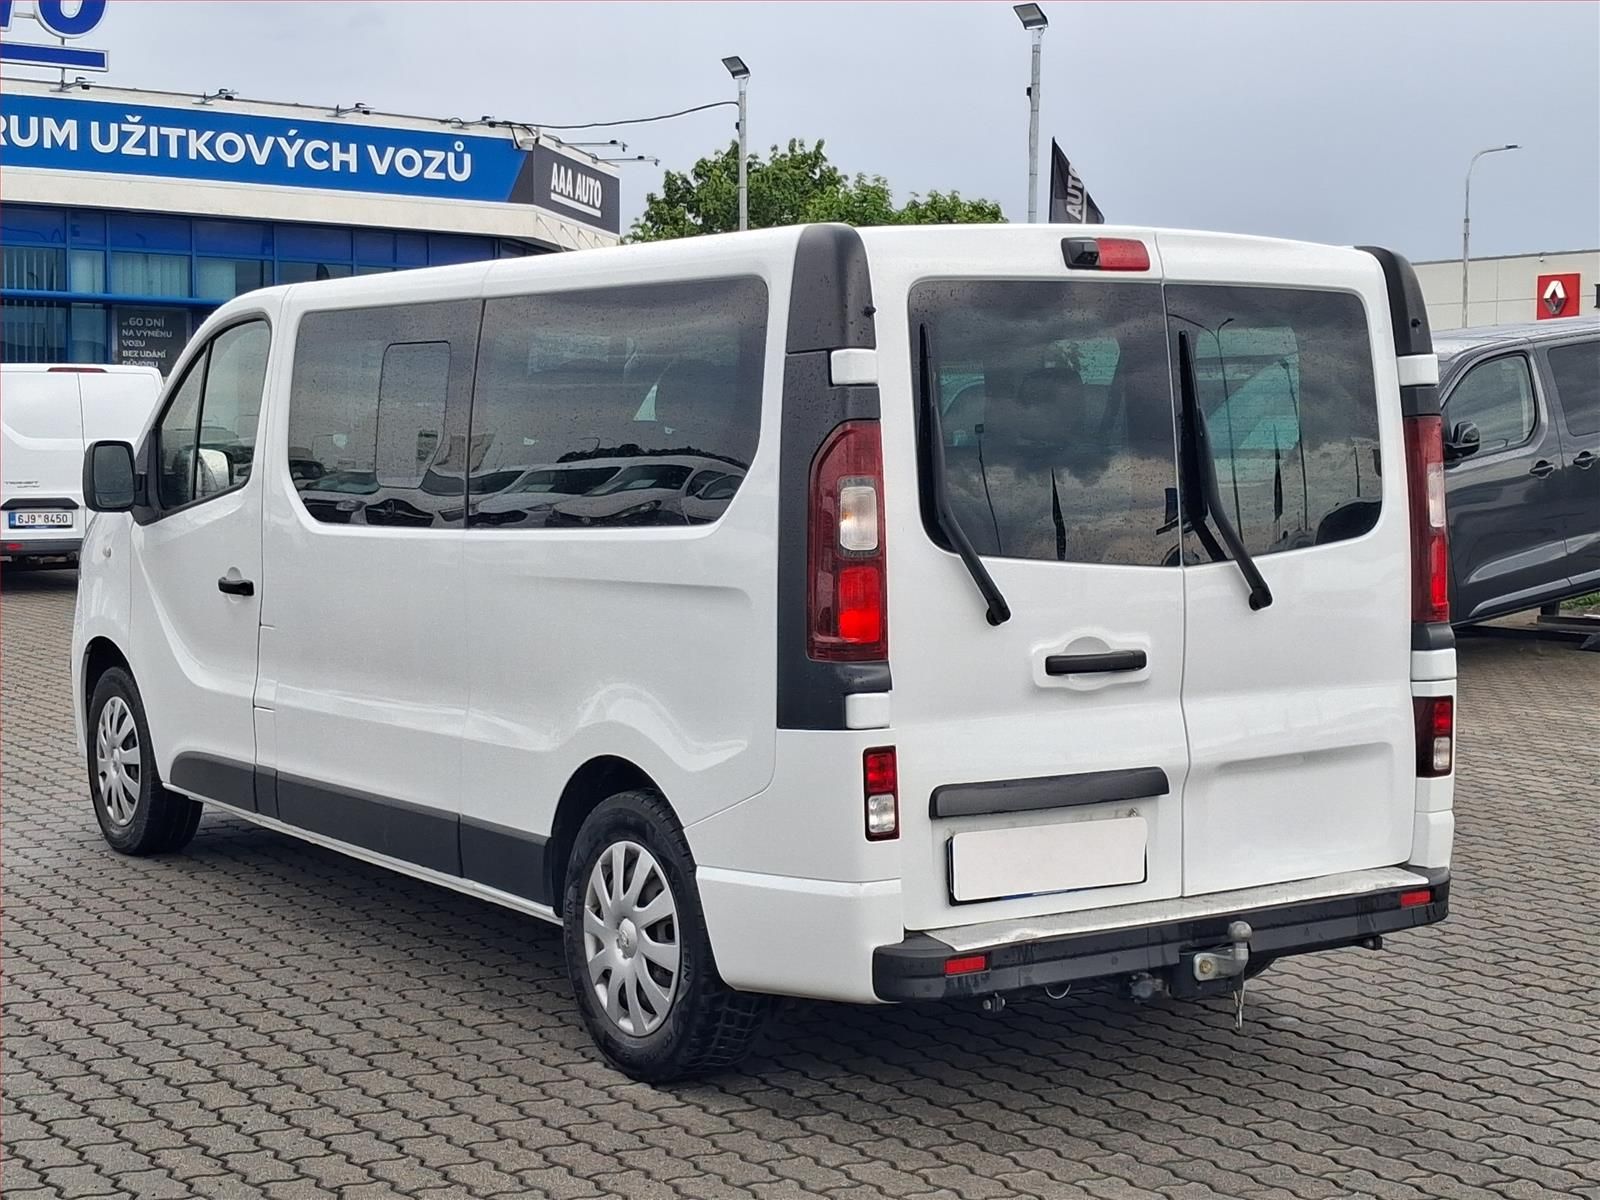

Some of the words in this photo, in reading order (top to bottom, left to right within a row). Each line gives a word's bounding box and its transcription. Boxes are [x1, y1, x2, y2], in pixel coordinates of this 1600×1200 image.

[90, 114, 357, 173] UŽITKOVÝCH
[367, 141, 472, 182] VOZŮ
[551, 162, 573, 198] AAA
[575, 172, 602, 209] AUTO
[128, 317, 144, 327] 60
[145, 316, 165, 327] DNÍ
[122, 329, 135, 337] NA
[122, 350, 139, 358] BEZ
[17, 514, 36, 524] 6J9
[43, 514, 68, 524] 8450
